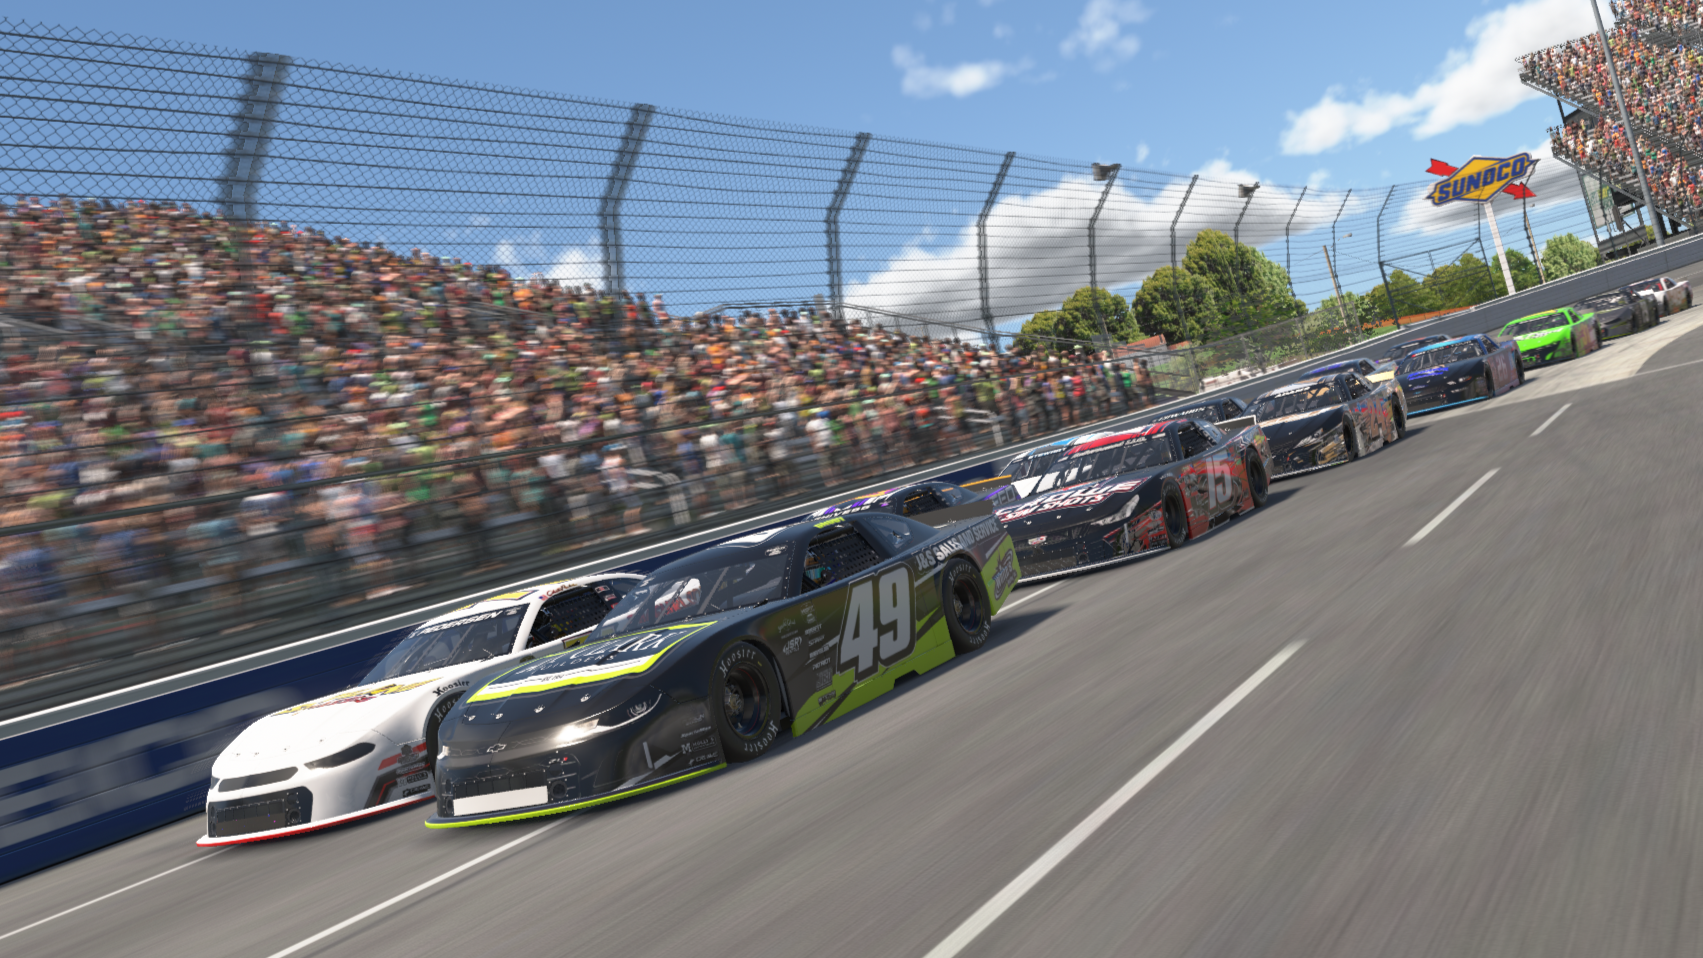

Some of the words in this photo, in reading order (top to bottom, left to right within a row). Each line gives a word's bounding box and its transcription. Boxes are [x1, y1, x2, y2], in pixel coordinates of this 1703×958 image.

[1438, 156, 1525, 202] SUNOCO
[1206, 455, 1232, 510] 15
[915, 549, 936, 571] J&S
[933, 536, 963, 561] SALES
[957, 529, 976, 549] AND
[973, 517, 1000, 540] SERVICE
[948, 563, 972, 582] Hoosier
[839, 565, 912, 674] 49
[719, 649, 756, 678] Hoosier
[432, 679, 470, 697] Hoosier
[744, 720, 778, 753] Hoosier
